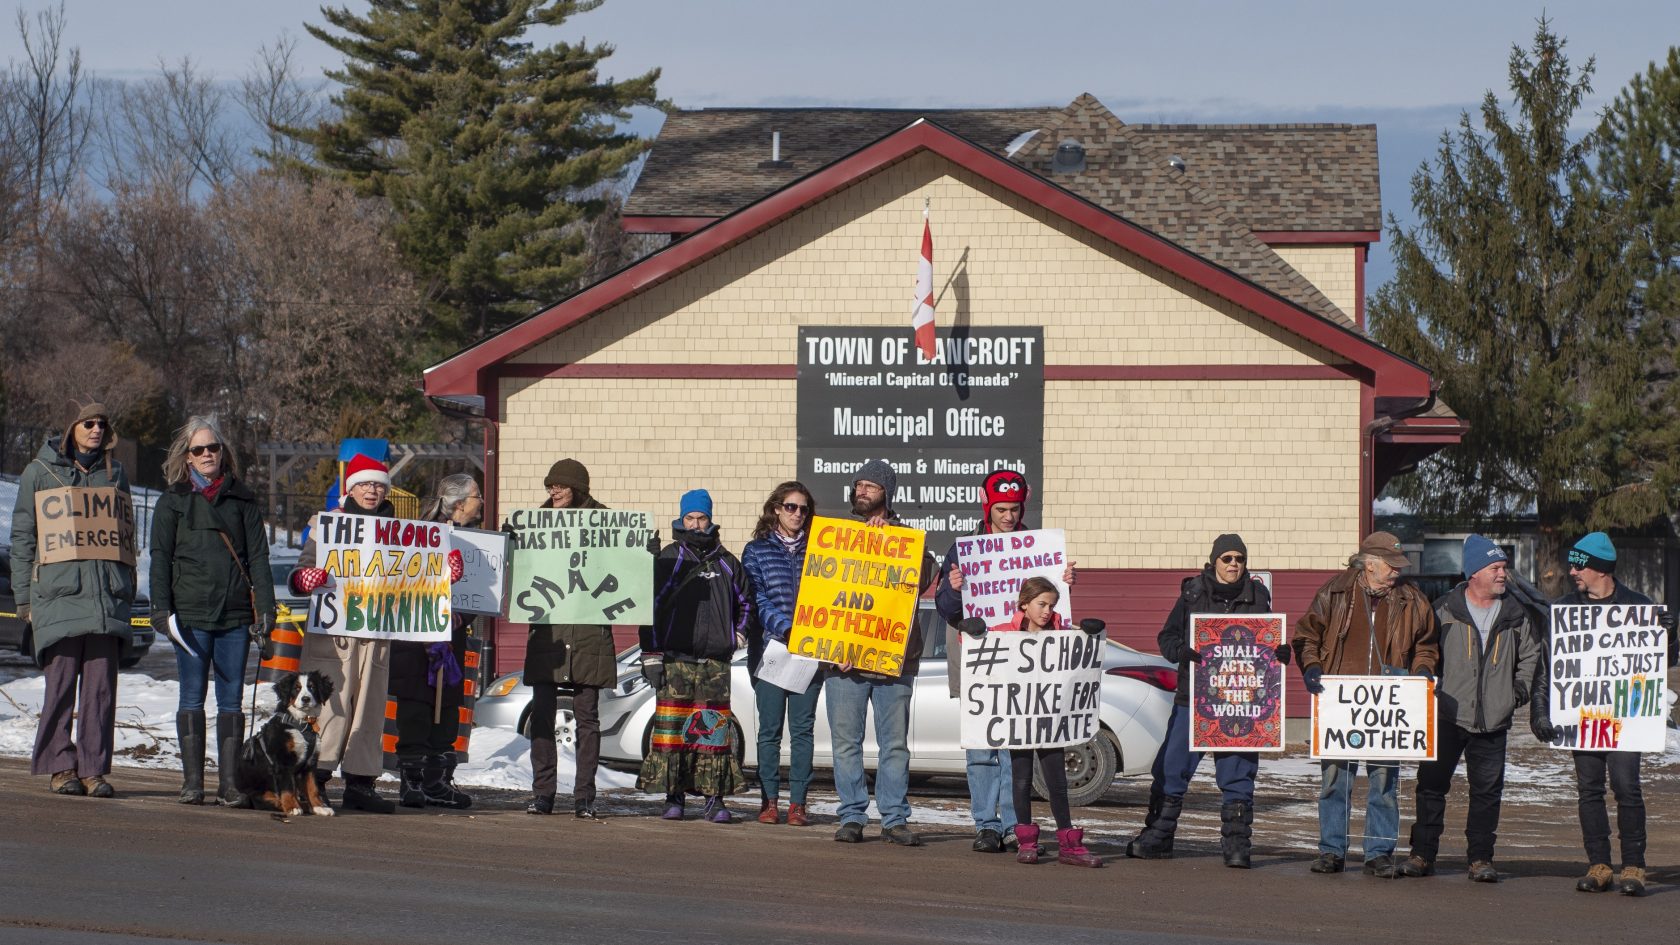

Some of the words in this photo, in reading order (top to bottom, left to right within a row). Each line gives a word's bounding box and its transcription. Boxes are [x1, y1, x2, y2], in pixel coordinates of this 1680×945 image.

[805, 336, 873, 365] TOWN
[881, 337, 909, 365] OF
[886, 372, 935, 389] Capital
[939, 372, 954, 386] Of
[834, 407, 934, 442] Municipal
[946, 408, 1005, 436] Office
[881, 458, 911, 474] em
[916, 459, 928, 474] &
[934, 459, 989, 474] Mineral
[993, 459, 1026, 474] Club
[320, 515, 365, 544] THE
[375, 518, 441, 548] WRONG
[512, 510, 584, 530] CLIMATE
[589, 510, 647, 528] CHANGE
[514, 531, 547, 550] HAS
[551, 530, 571, 549] ME
[579, 529, 621, 548] BENT
[625, 529, 655, 548] OUT
[817, 525, 915, 559] CHANGE
[958, 540, 974, 556] IF
[977, 538, 1004, 554] YOU
[1011, 535, 1035, 550] DO
[324, 549, 443, 577] AMAZON
[570, 551, 588, 568] OF
[961, 560, 993, 577] NOT
[998, 551, 1063, 571] CHANGE
[805, 553, 919, 595] NOTHING
[516, 568, 637, 622] SHAPE
[832, 591, 875, 611] AND
[313, 592, 338, 629] IS
[345, 591, 449, 633] BURNING
[796, 605, 906, 644] NOTHING
[1553, 606, 1603, 634] KEEP
[798, 636, 904, 675] CHANGES
[966, 637, 1010, 676] #
[1018, 635, 1102, 673] SCHOOL
[1213, 645, 1260, 658] SMALL
[1553, 633, 1594, 656] AND
[1598, 630, 1665, 649] CARRY
[1219, 660, 1255, 672] ACTS
[1553, 658, 1581, 680] ON
[1621, 652, 1664, 675] JUST
[1209, 675, 1264, 687] CHANGE
[1338, 684, 1400, 705] LOVE
[968, 683, 1063, 716] STRIKE
[1070, 681, 1100, 712] FOR
[1223, 690, 1250, 702] THE
[1553, 680, 1612, 711] YOUR
[1613, 678, 1664, 718] HOME
[1211, 704, 1261, 717] WORLD
[1351, 708, 1409, 727] YOUR
[987, 713, 1092, 747] CLIMATE
[1324, 728, 1427, 750] MOTHER
[1552, 724, 1578, 747] ON
[1579, 716, 1620, 749] FIRE
